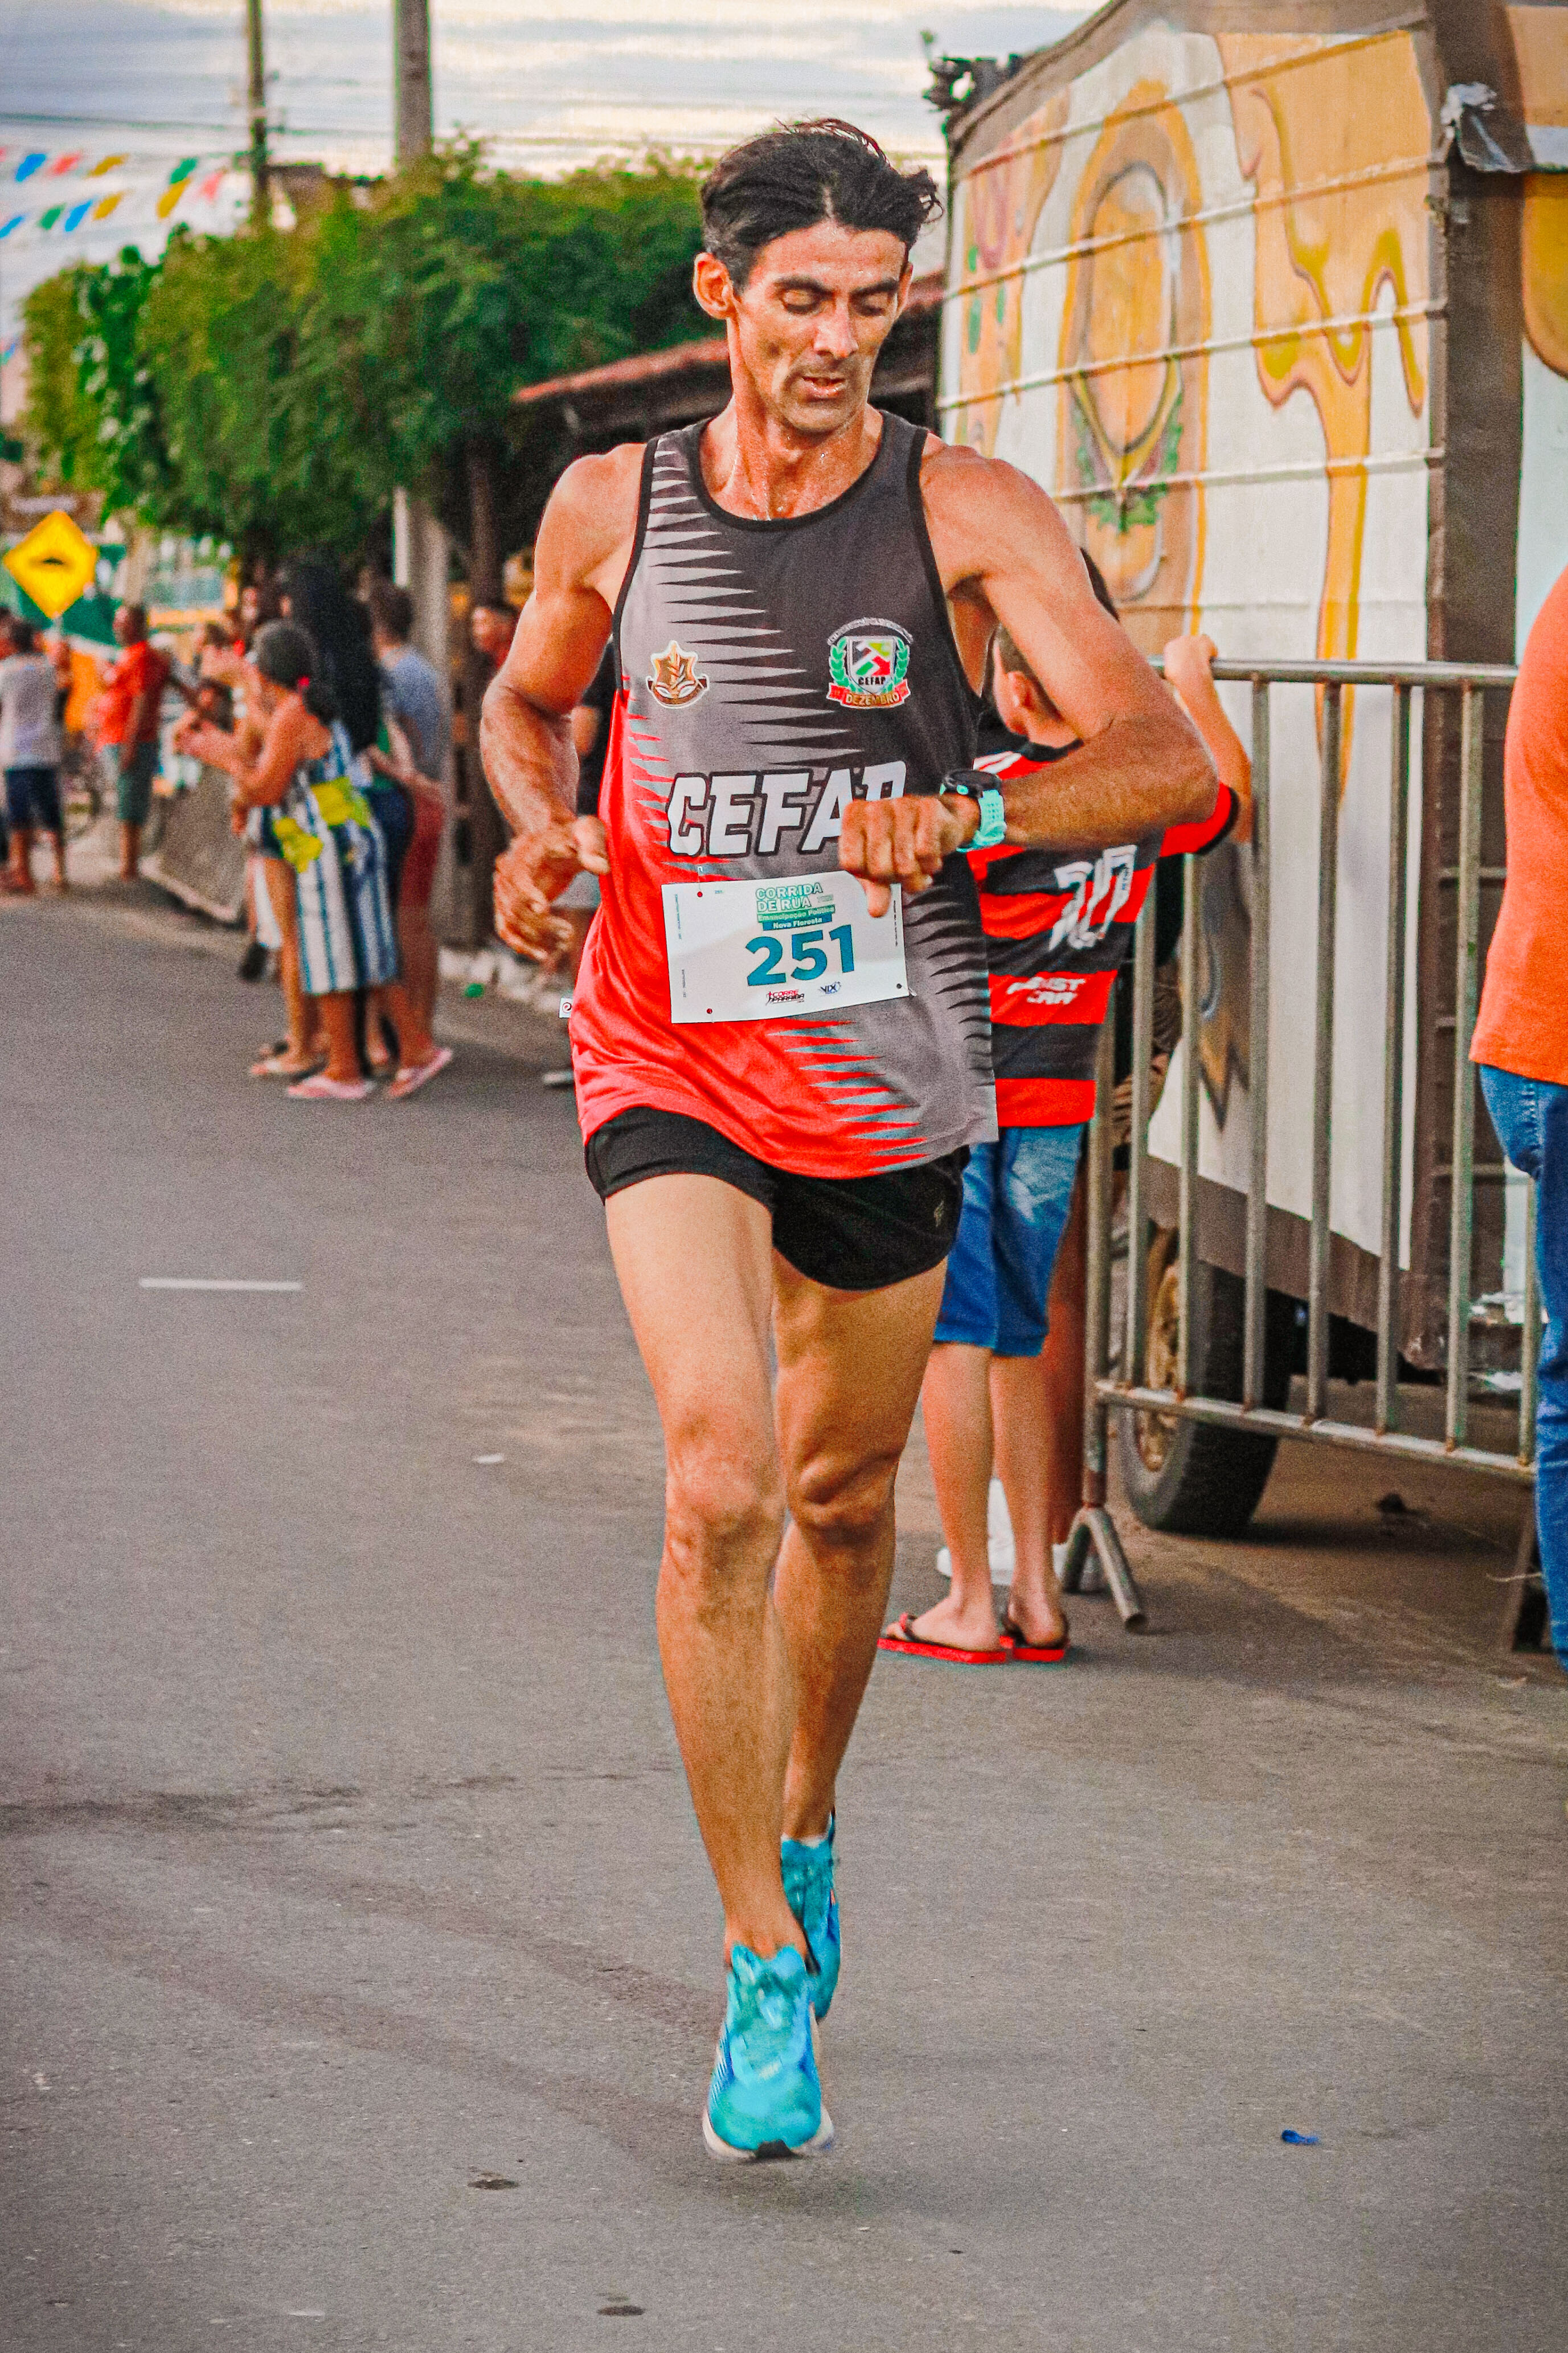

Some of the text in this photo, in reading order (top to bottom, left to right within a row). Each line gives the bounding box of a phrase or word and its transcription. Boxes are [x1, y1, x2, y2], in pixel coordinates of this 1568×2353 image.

[858, 676, 886, 685] CEFAP
[756, 883, 823, 900] CORRIDA
[757, 900, 777, 912] DE
[781, 896, 812, 910] RUA
[793, 917, 822, 927] Floresta
[746, 925, 854, 986] 251
